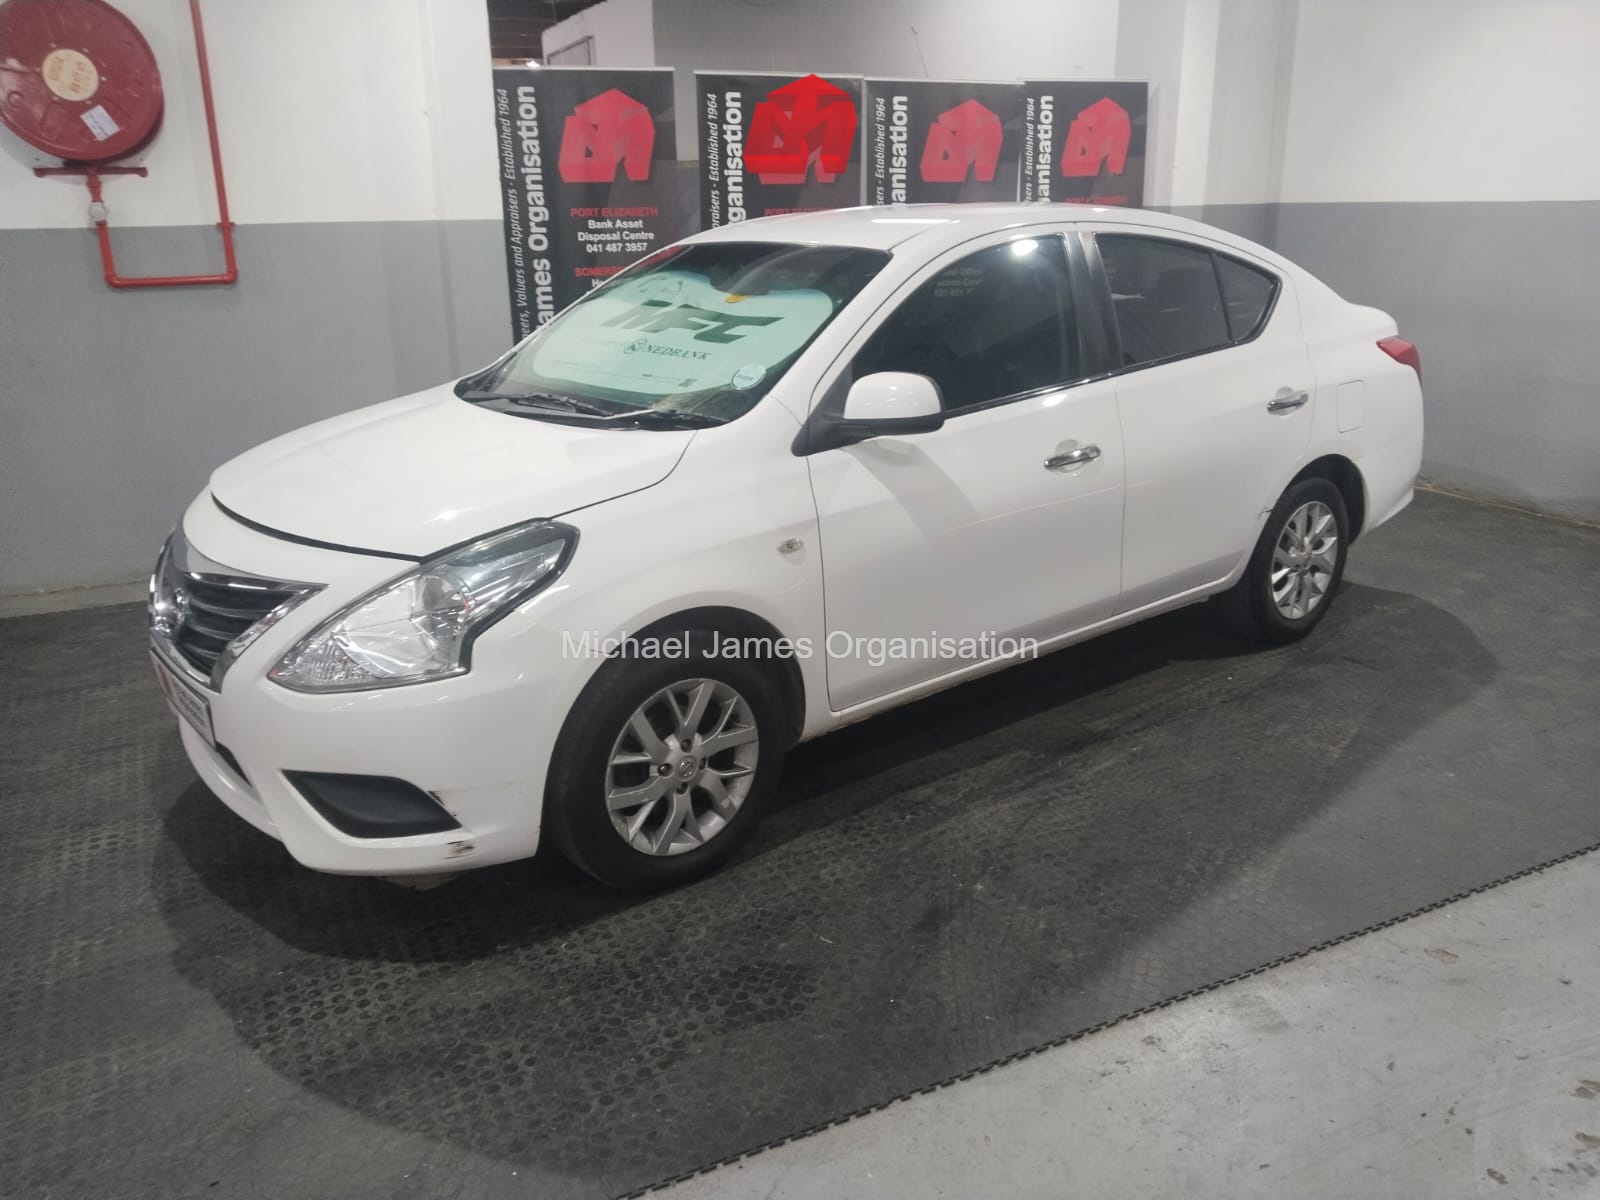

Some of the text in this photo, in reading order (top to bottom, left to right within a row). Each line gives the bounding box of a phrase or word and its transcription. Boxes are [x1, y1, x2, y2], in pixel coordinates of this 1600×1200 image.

[497, 88, 509, 115] 1964
[707, 93, 717, 119] 1964
[876, 97, 885, 121] 1964
[1026, 97, 1034, 120] 1964
[499, 118, 515, 180] Established
[708, 122, 719, 181] Established
[875, 123, 885, 178] Established
[889, 96, 908, 206] anisation
[1025, 122, 1034, 175] Established
[507, 188, 523, 245] Appraisers
[516, 86, 555, 329] ames Organisation
[570, 207, 658, 217] PORT ELIZABETH
[577, 231, 655, 242] Disposal Centre
[588, 219, 643, 229] Bank Asset
[511, 245, 523, 267] and
[586, 242, 647, 252] 041 487 3957
[515, 269, 528, 307] Valuers
[643, 343, 712, 361] NEDBANK
